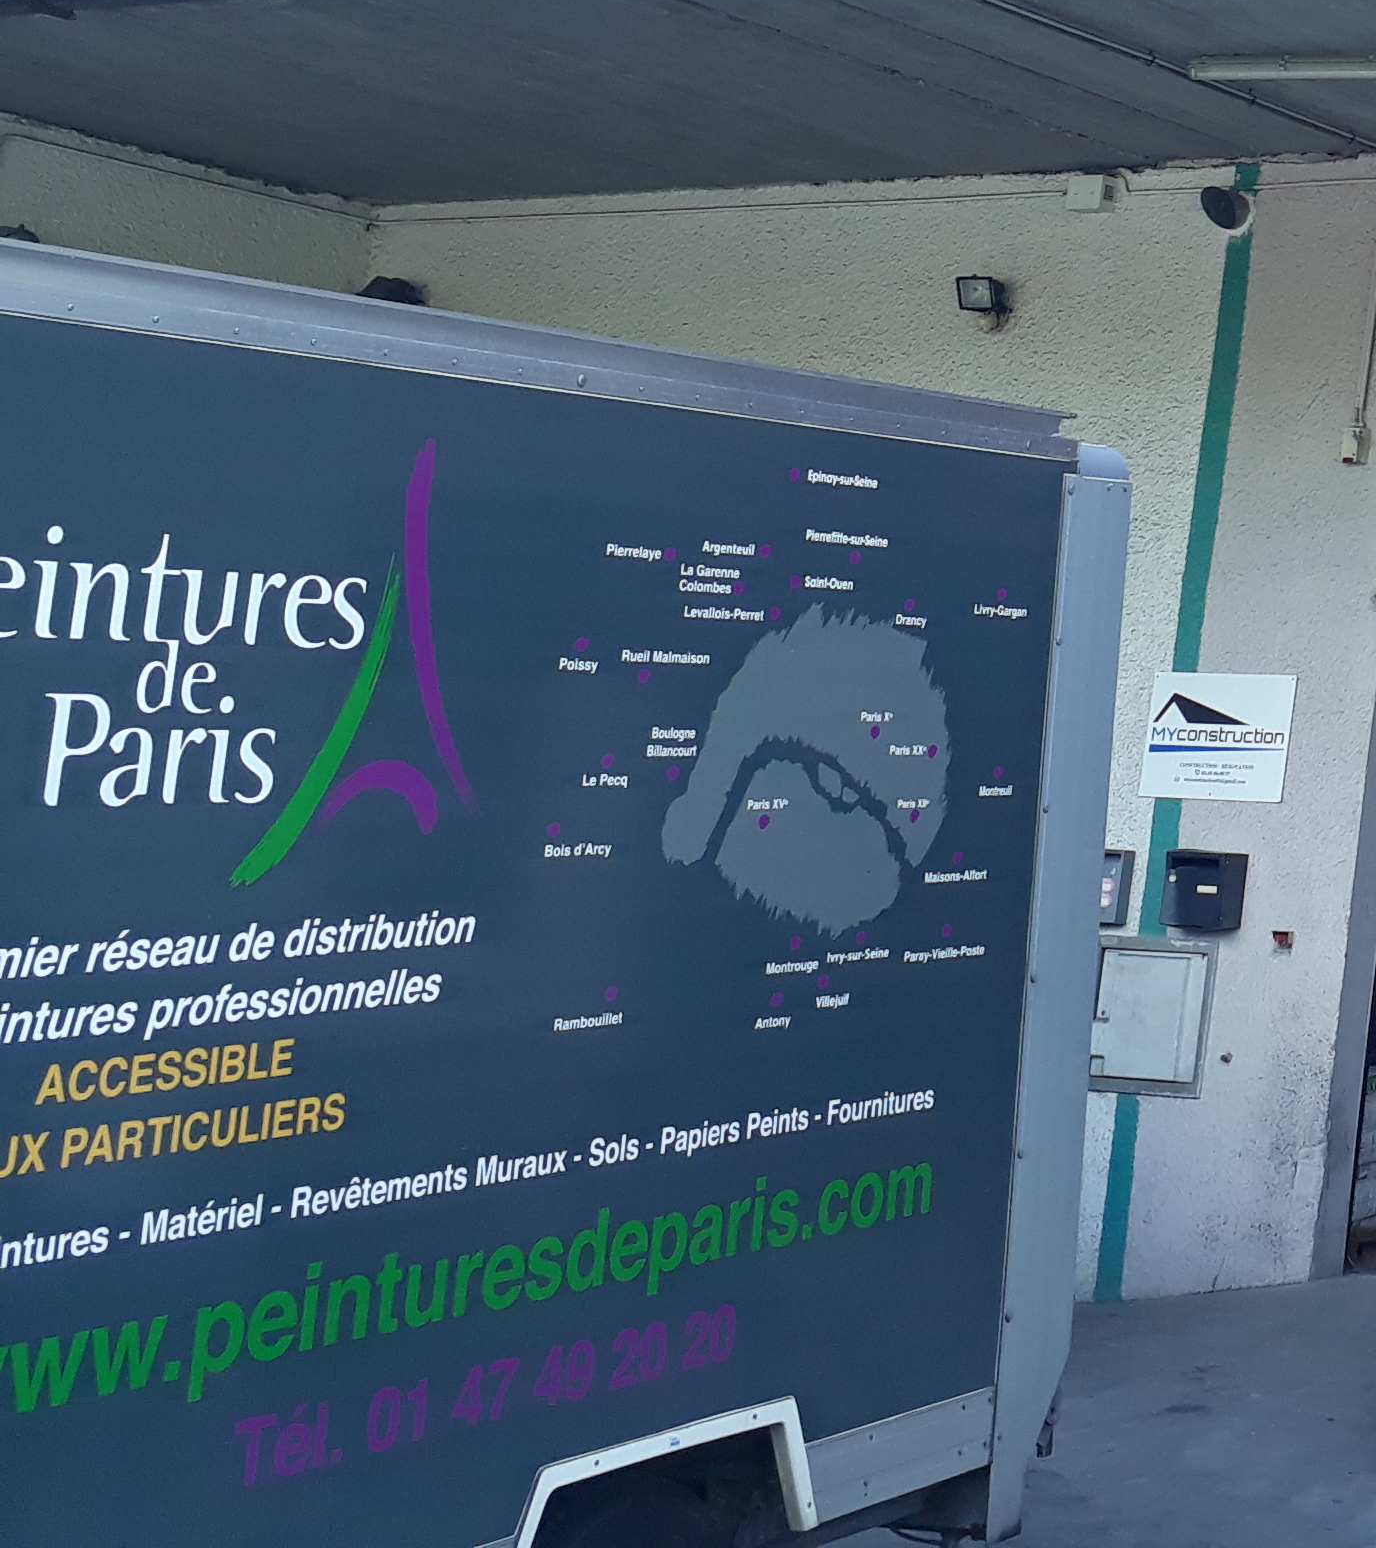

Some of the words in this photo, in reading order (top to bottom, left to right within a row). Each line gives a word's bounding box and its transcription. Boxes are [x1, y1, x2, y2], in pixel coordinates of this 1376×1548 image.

[606, 543, 662, 562] Pierrelaye
[702, 540, 756, 557] Argenteuil
[680, 563, 694, 576] La
[696, 564, 741, 579] Garenne
[679, 579, 732, 594] Colombes
[684, 605, 765, 621] Levallois-Perret
[895, 614, 927, 629] Drancy
[621, 649, 650, 663] Rueil
[652, 651, 711, 665] Malmaison
[558, 658, 599, 674] Poissy
[136, 640, 217, 714] de
[860, 711, 882, 723] Paris
[651, 727, 697, 742] Boulogne
[1150, 726, 1285, 745] MYconstruction
[43, 693, 277, 808] Paris
[646, 745, 698, 758] Billancourt
[889, 745, 911, 756] Paris
[582, 773, 597, 786] Le
[599, 774, 629, 788] Pecq
[747, 799, 771, 810] Paris
[544, 844, 571, 858] Bois
[573, 842, 613, 858] d'Arcy
[84, 927, 221, 974] réseau
[228, 923, 276, 966] de
[282, 909, 477, 959] distribution
[827, 947, 890, 965] Ivry-sur-Seine
[765, 960, 819, 975] Montrouge
[143, 968, 444, 1041] professionnelles
[553, 1012, 623, 1032] Rambouillet
[754, 1015, 792, 1030] Antony
[35, 1038, 296, 1106] ACCESSIBLE
[60, 1092, 347, 1170] PARTICULIERS
[140, 1193, 265, 1245] Matériel
[290, 1163, 468, 1220] Revêtements
[474, 1149, 568, 1187] Muraux
[588, 1133, 640, 1168] Sols
[660, 1116, 741, 1157] Papiers
[746, 1105, 810, 1141] Peints
[827, 1087, 936, 1126] Fournitures
[0, 1161, 934, 1413] ww.peinturesdeparis.com
[233, 1401, 343, 1487] Tél.
[367, 1378, 430, 1454] 01
[451, 1357, 521, 1426] 47
[533, 1339, 596, 1407] 49
[608, 1320, 669, 1392] 20
[683, 1303, 737, 1372] 20
